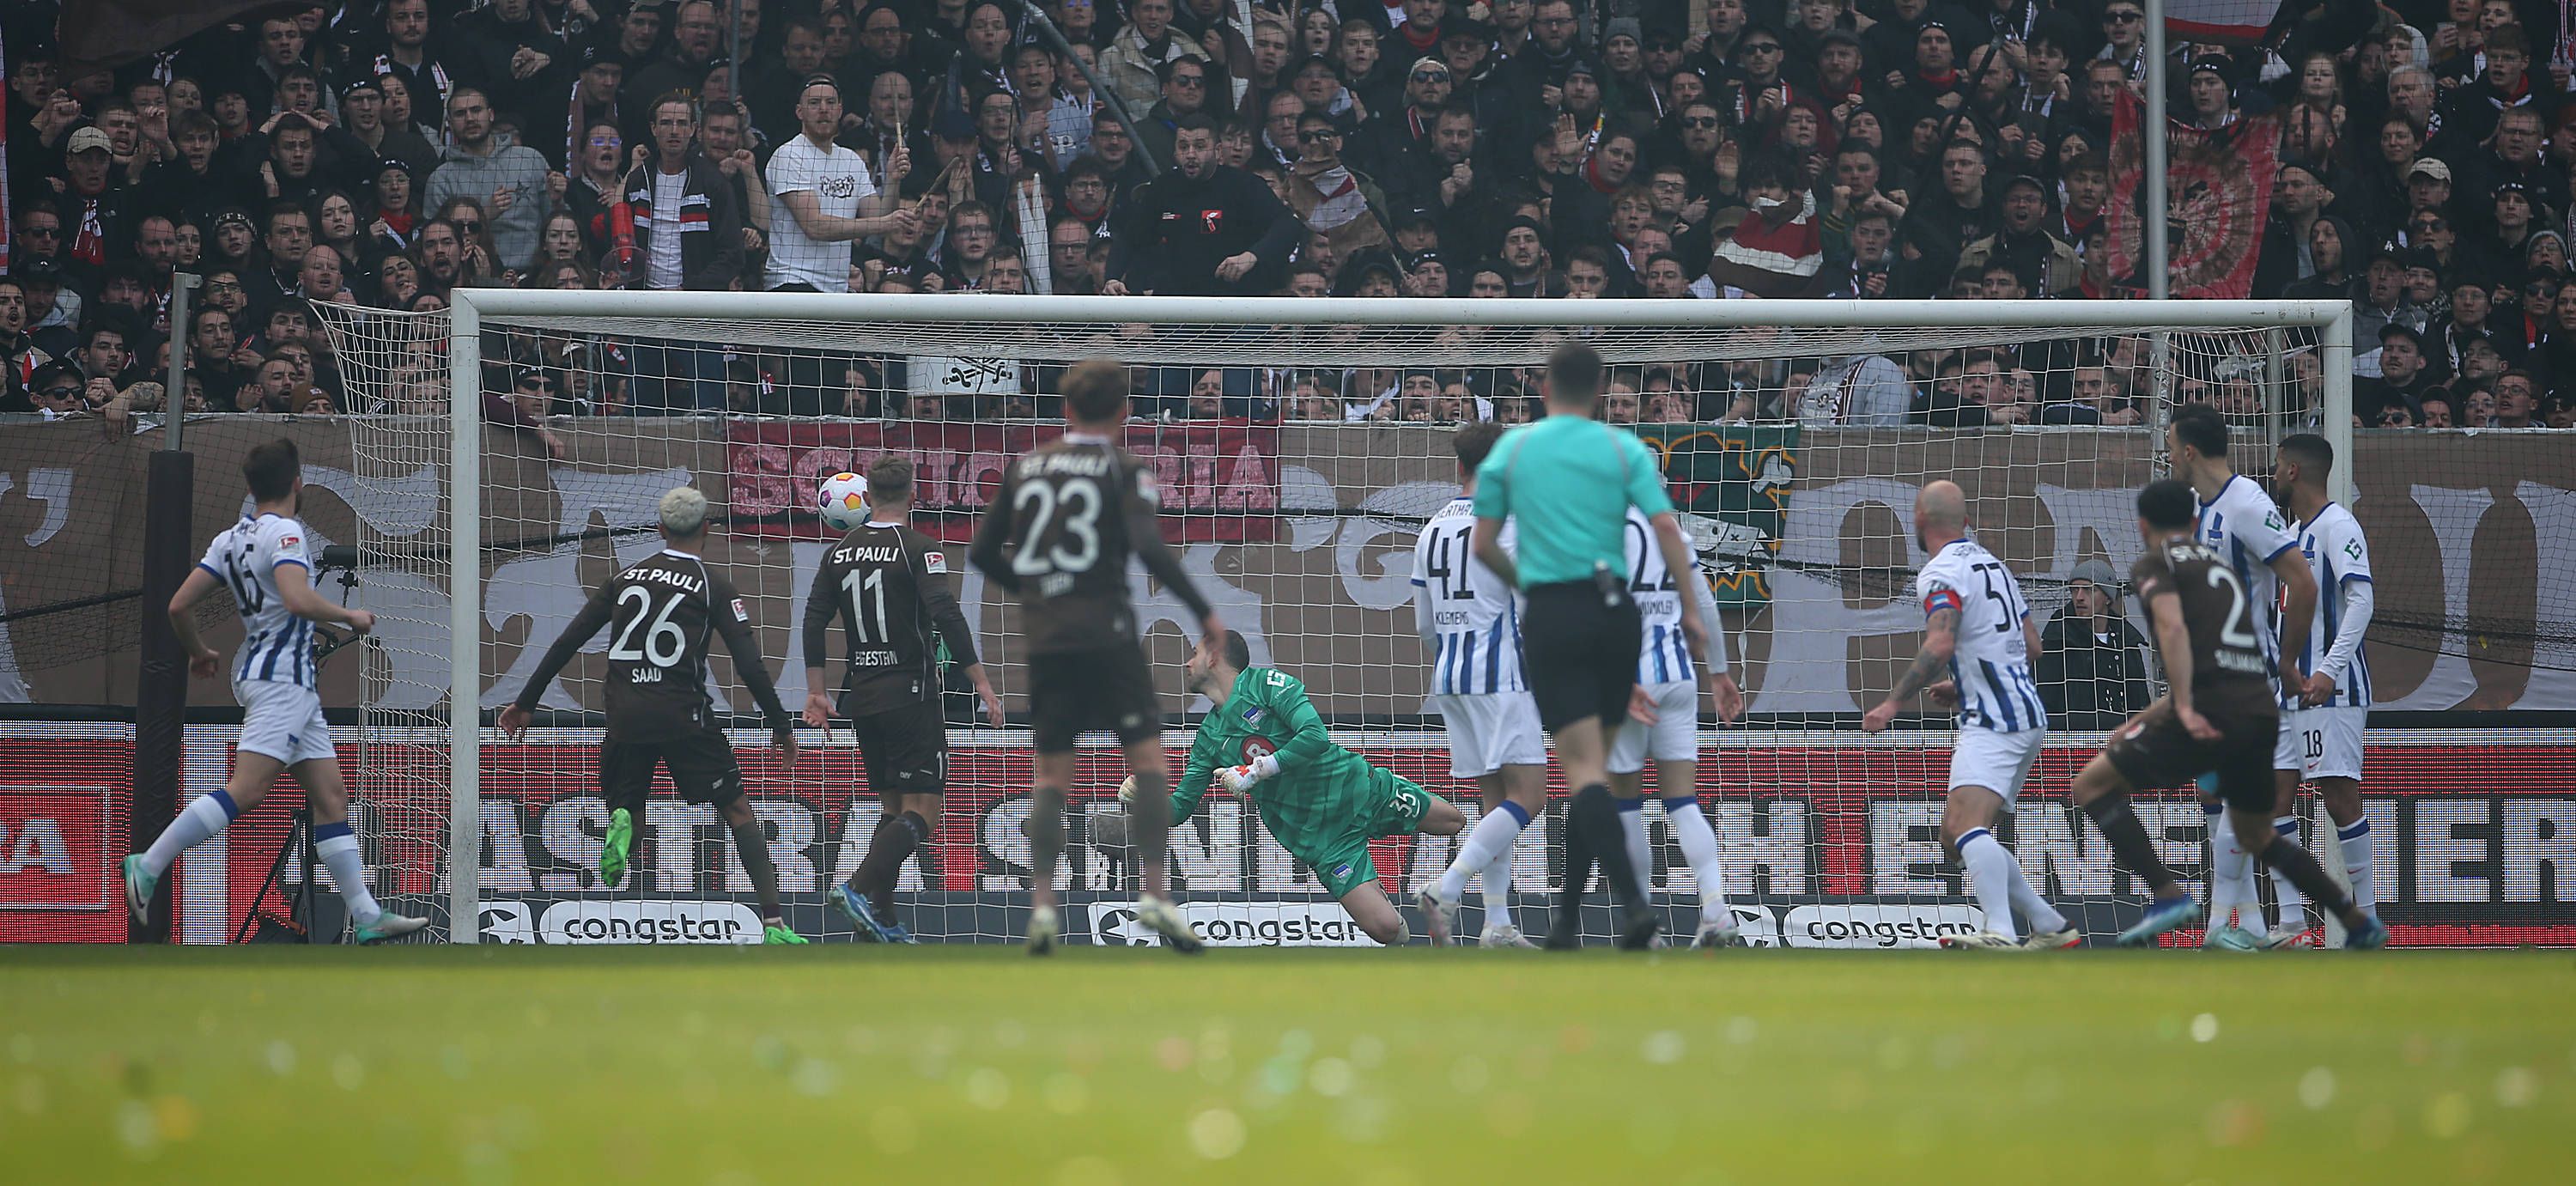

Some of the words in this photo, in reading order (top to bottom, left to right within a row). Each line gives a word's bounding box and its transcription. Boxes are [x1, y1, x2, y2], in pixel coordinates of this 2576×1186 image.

[1013, 477, 1103, 575] 23
[855, 547, 899, 563] PAULI
[1427, 526, 1473, 600] 41
[623, 569, 647, 581] ST.
[647, 569, 703, 593] PAULI
[841, 569, 889, 643] 11
[1971, 562, 2020, 633] 37
[2208, 565, 2256, 648] 2
[608, 585, 686, 668] 26
[1435, 611, 1469, 625] KLEMENS
[631, 668, 661, 684] SAAD
[2302, 729, 2323, 757] 18
[1388, 789, 1421, 818] 35
[564, 913, 741, 945] congstar
[1190, 914, 1364, 946] congstar
